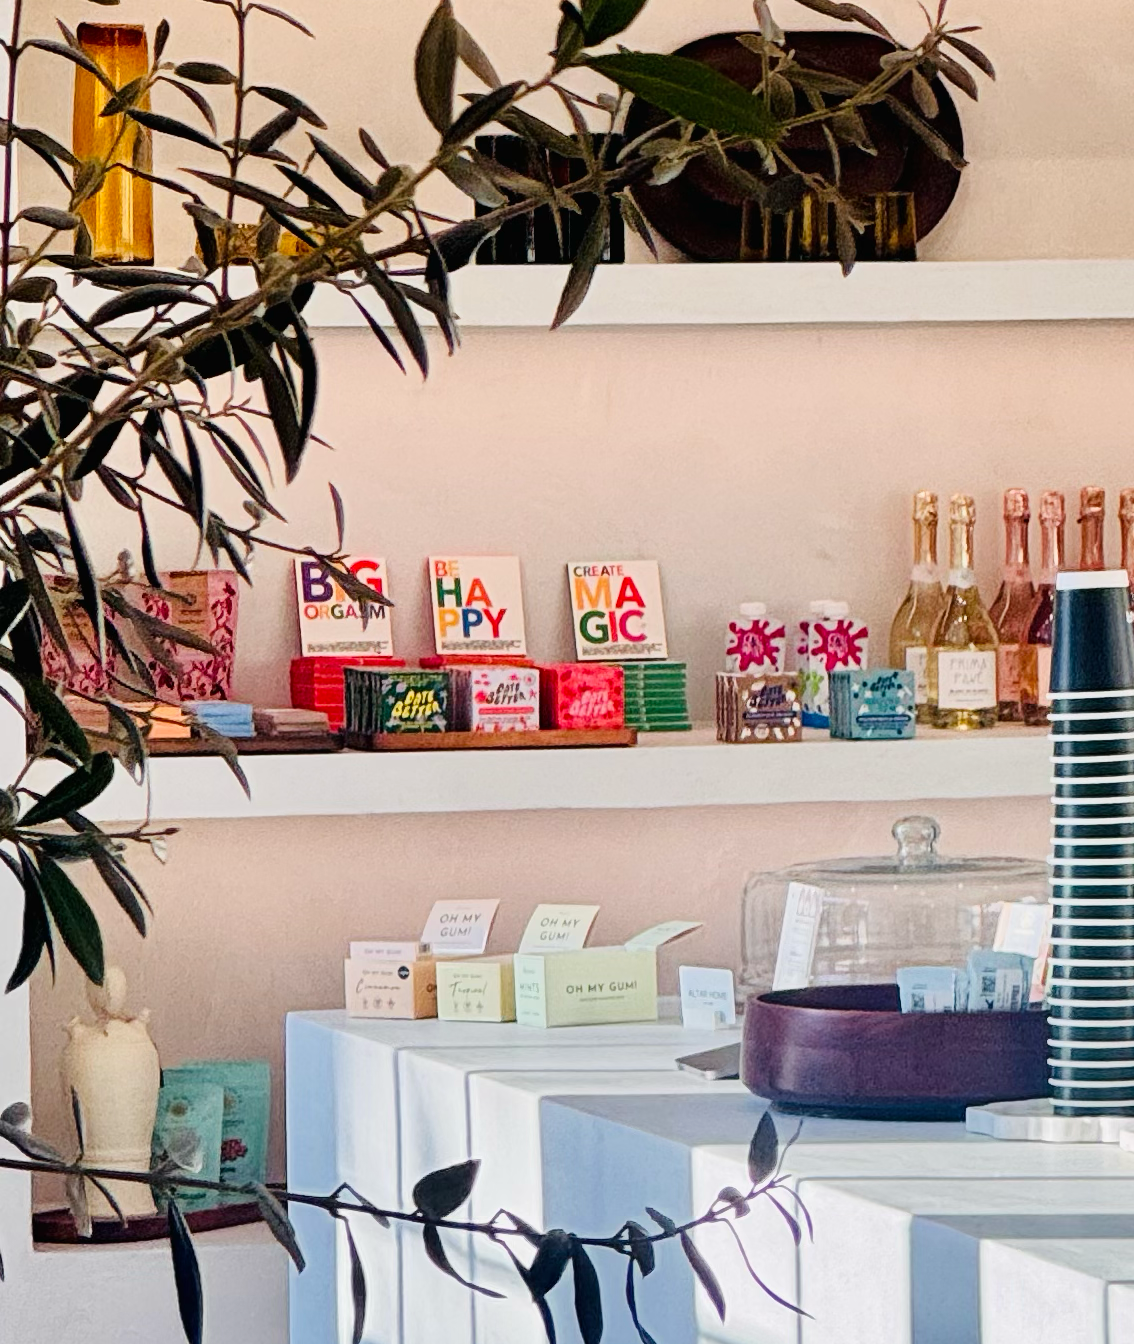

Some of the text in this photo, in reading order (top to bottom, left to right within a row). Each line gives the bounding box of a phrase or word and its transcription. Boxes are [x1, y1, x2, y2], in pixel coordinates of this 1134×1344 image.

[435, 560, 460, 577] BE
[573, 565, 624, 577] CREATE
[436, 578, 493, 608] HA
[575, 576, 646, 610] MA
[304, 603, 385, 620] ORGAM
[439, 608, 507, 638] PPY
[579, 609, 648, 644] GIC
[440, 913, 481, 924] OH MY
[540, 917, 581, 928] OH MY
[440, 926, 472, 937] GUM!
[540, 931, 569, 941] GUM!
[566, 980, 637, 994] OH MY GUM!
